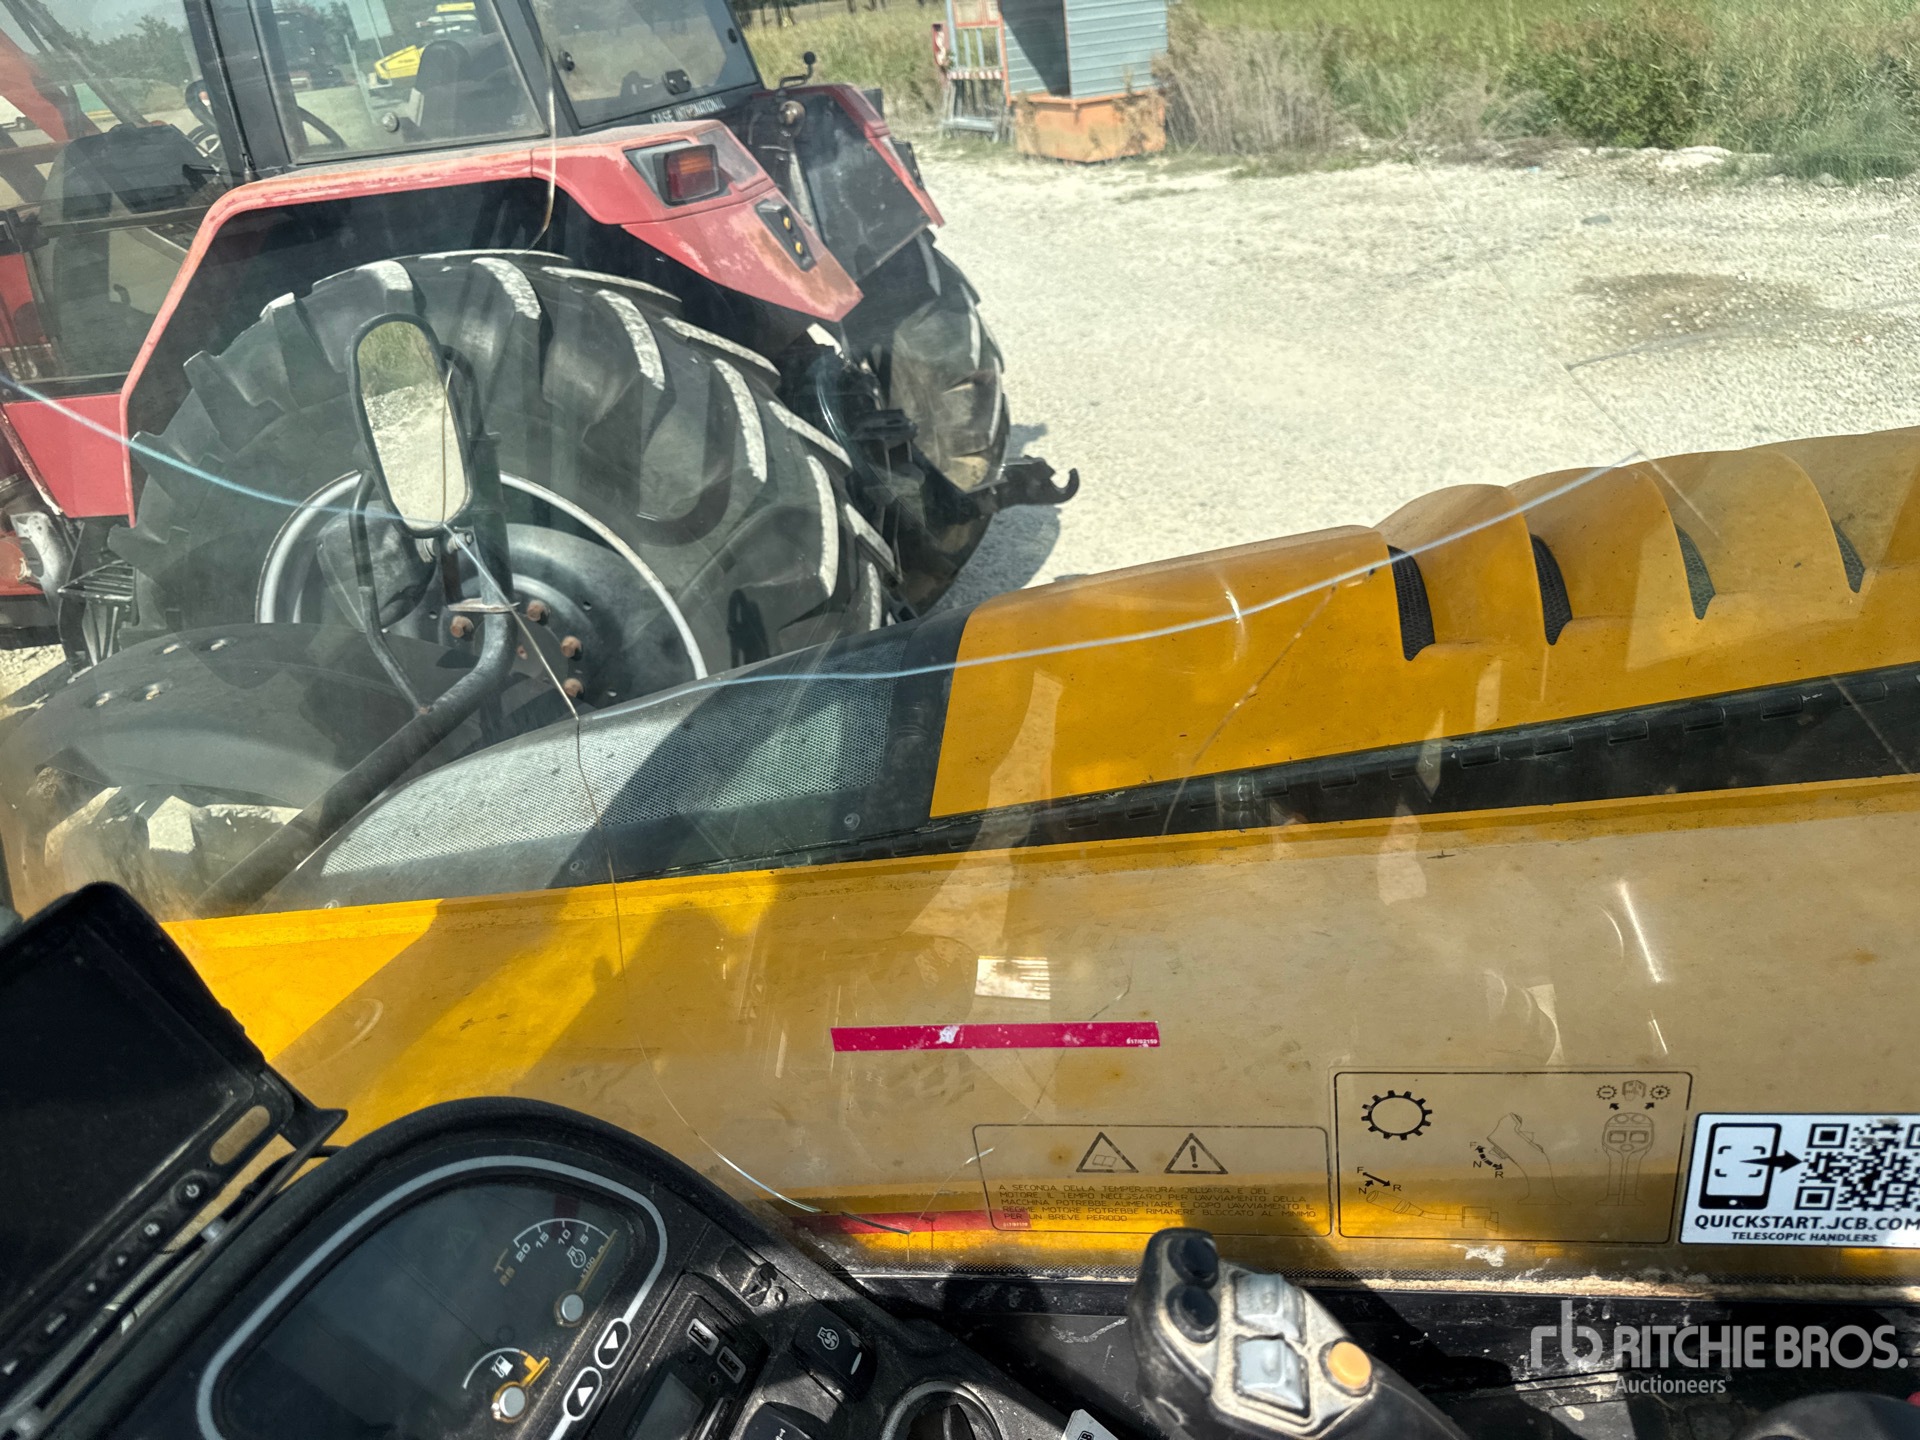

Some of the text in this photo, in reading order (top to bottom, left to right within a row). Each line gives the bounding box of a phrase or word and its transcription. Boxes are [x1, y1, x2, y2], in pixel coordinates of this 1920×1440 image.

[1281, 1210, 1317, 1218] MINIMO
[535, 1232, 549, 1248] 15
[558, 1229, 571, 1245] 10
[1732, 1231, 1878, 1243] TELESCOPIC HANDLERS
[515, 1243, 531, 1263] 20
